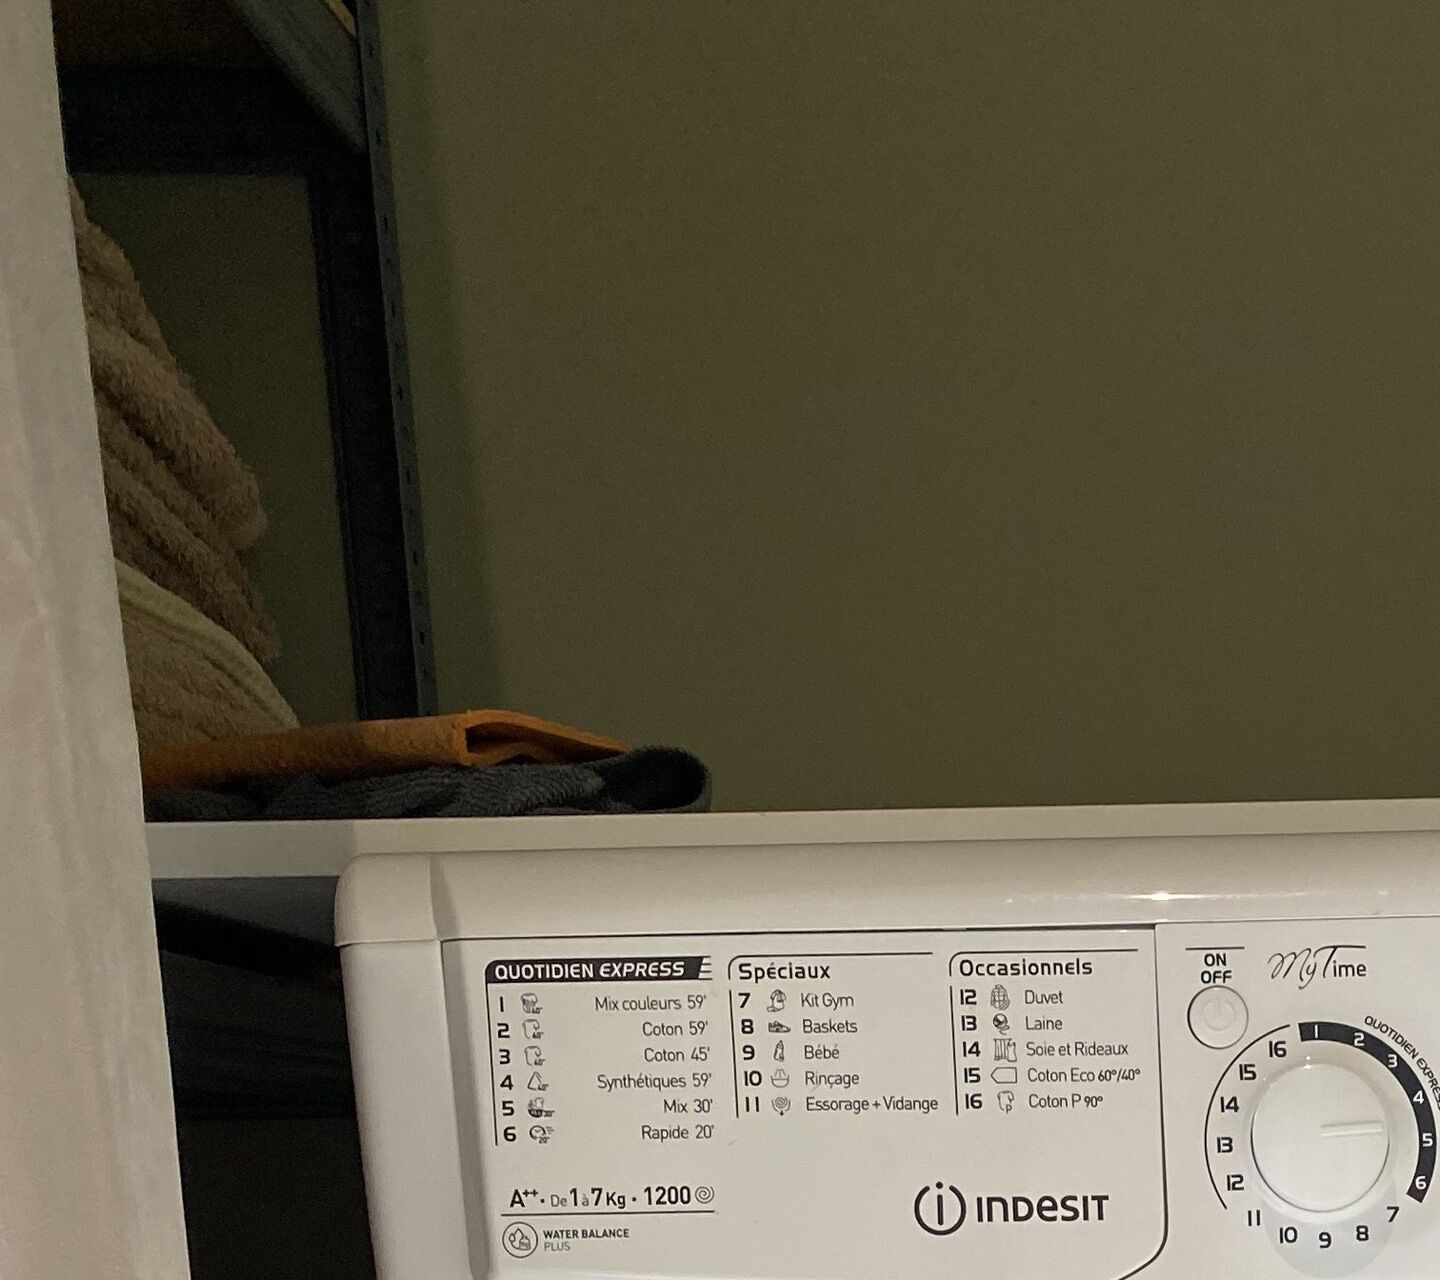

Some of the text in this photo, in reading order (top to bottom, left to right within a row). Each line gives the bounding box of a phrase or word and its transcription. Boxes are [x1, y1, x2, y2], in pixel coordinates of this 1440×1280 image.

[959, 958, 1093, 978] Occasionnels
[1204, 953, 1227, 967] ON
[494, 961, 686, 981] QUOTIDIEN EXPRESS
[737, 962, 831, 984] Spéciaux
[1200, 970, 1232, 984] OFF
[499, 996, 504, 1012] 1
[595, 997, 620, 1011] Mix
[622, 995, 681, 1010] couleurs
[738, 993, 854, 1010] 7 Kit Gym
[959, 989, 1064, 1006] 12 Duvet
[497, 1023, 510, 1038] 2
[642, 1022, 683, 1036] Coton
[741, 1018, 858, 1034] 8 Baskets
[961, 1016, 1063, 1031] 13 Laine
[1313, 1024, 1319, 1039] 1
[1353, 1032, 1365, 1047] 2
[1364, 1015, 1419, 1060] QUOTIDIEN
[499, 1049, 511, 1064] 3
[644, 1047, 685, 1062] Coton
[742, 1044, 840, 1060] 9 Bébé
[962, 1041, 1129, 1058] 14 Soie et Rideaux
[1268, 1041, 1287, 1058] 16
[1387, 1053, 1398, 1068] 3
[744, 1071, 860, 1089] 10 Rinçage
[963, 1068, 981, 1084] 15
[1027, 1068, 1067, 1083] Coton
[1071, 1068, 1095, 1082] Eco
[1239, 1064, 1257, 1081] 15
[500, 1075, 514, 1091] 4
[597, 1073, 687, 1092] Synthétiques
[745, 1097, 760, 1113] 11
[806, 1097, 870, 1114] Essorage
[883, 1096, 939, 1113] Vidange
[965, 1094, 982, 1110] 16
[1028, 1094, 1068, 1109] Coton
[1071, 1094, 1081, 1108] P
[1220, 1096, 1239, 1113] 14
[1412, 1090, 1425, 1104] 4
[502, 1100, 515, 1116] 5
[663, 1099, 688, 1113] Mix
[503, 1126, 517, 1142] 6
[641, 1125, 688, 1143] Rapide
[1422, 1133, 1433, 1147] 5
[1217, 1137, 1233, 1153] 13
[1226, 1175, 1244, 1191] 12
[1415, 1175, 1426, 1190] 6
[551, 1195, 567, 1207] De
[570, 1188, 578, 1206] 1
[582, 1194, 590, 1206] à
[591, 1188, 603, 1205] 7
[606, 1191, 626, 1209] Kg
[643, 1186, 691, 1205] 1200
[1248, 1210, 1261, 1226] 11
[1387, 1206, 1399, 1222] 7
[543, 1227, 629, 1240] WATER BALANCE
[1279, 1227, 1298, 1244] 10
[1319, 1232, 1332, 1248] 9
[1356, 1226, 1369, 1241] 8
[543, 1241, 570, 1251] PLUS
